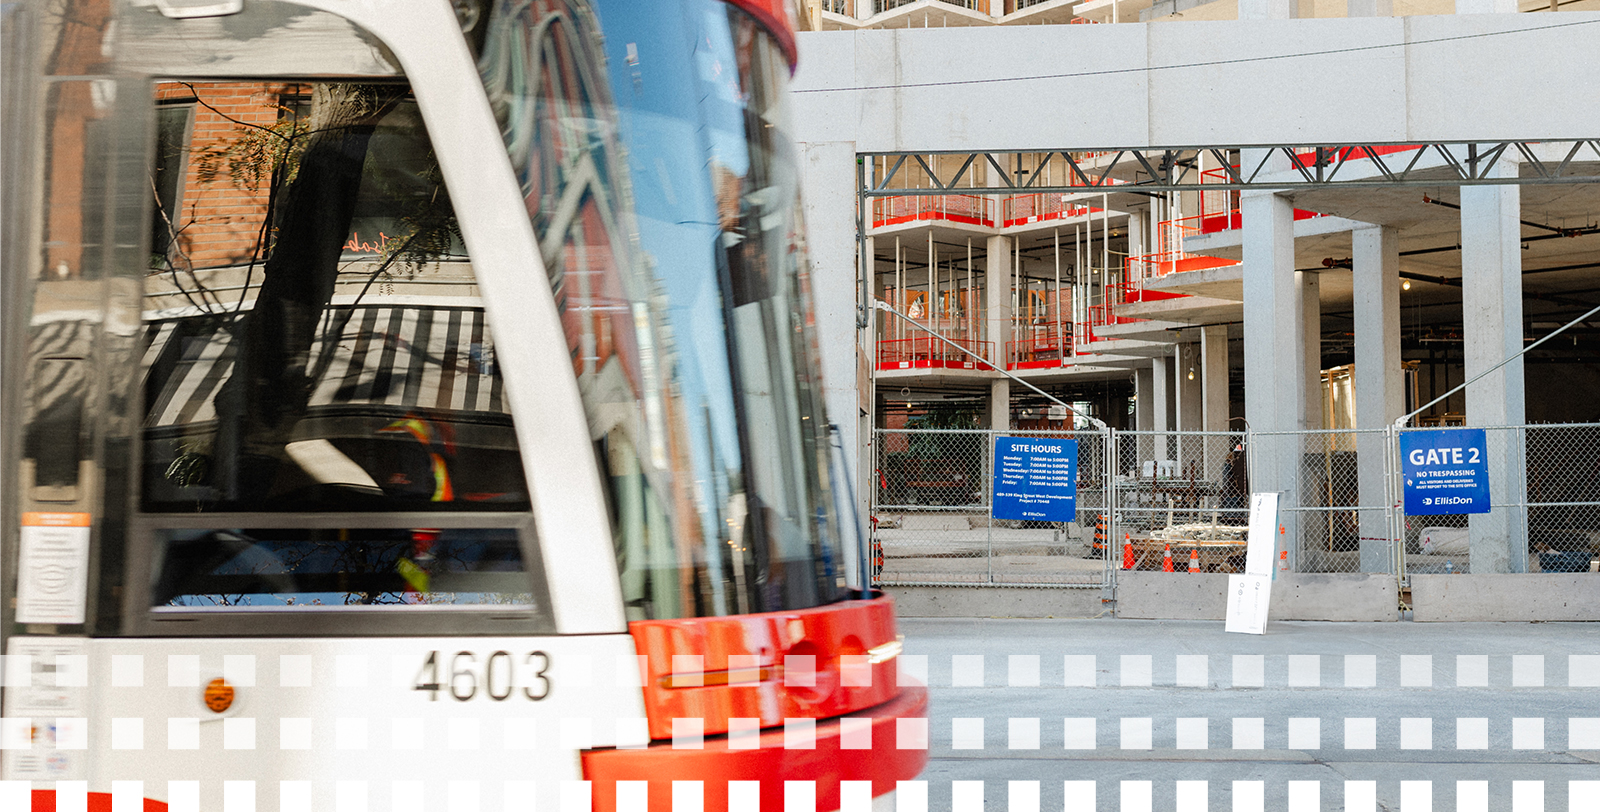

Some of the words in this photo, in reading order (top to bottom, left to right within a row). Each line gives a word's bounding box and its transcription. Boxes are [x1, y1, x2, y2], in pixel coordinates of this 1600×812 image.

[1011, 444, 1029, 452] SITE
[1031, 445, 1061, 453] HOURS
[1410, 448, 1463, 465] GATE
[1468, 448, 1480, 463] 2
[1435, 497, 1472, 505] EllisDon
[411, 650, 550, 701] 4603
